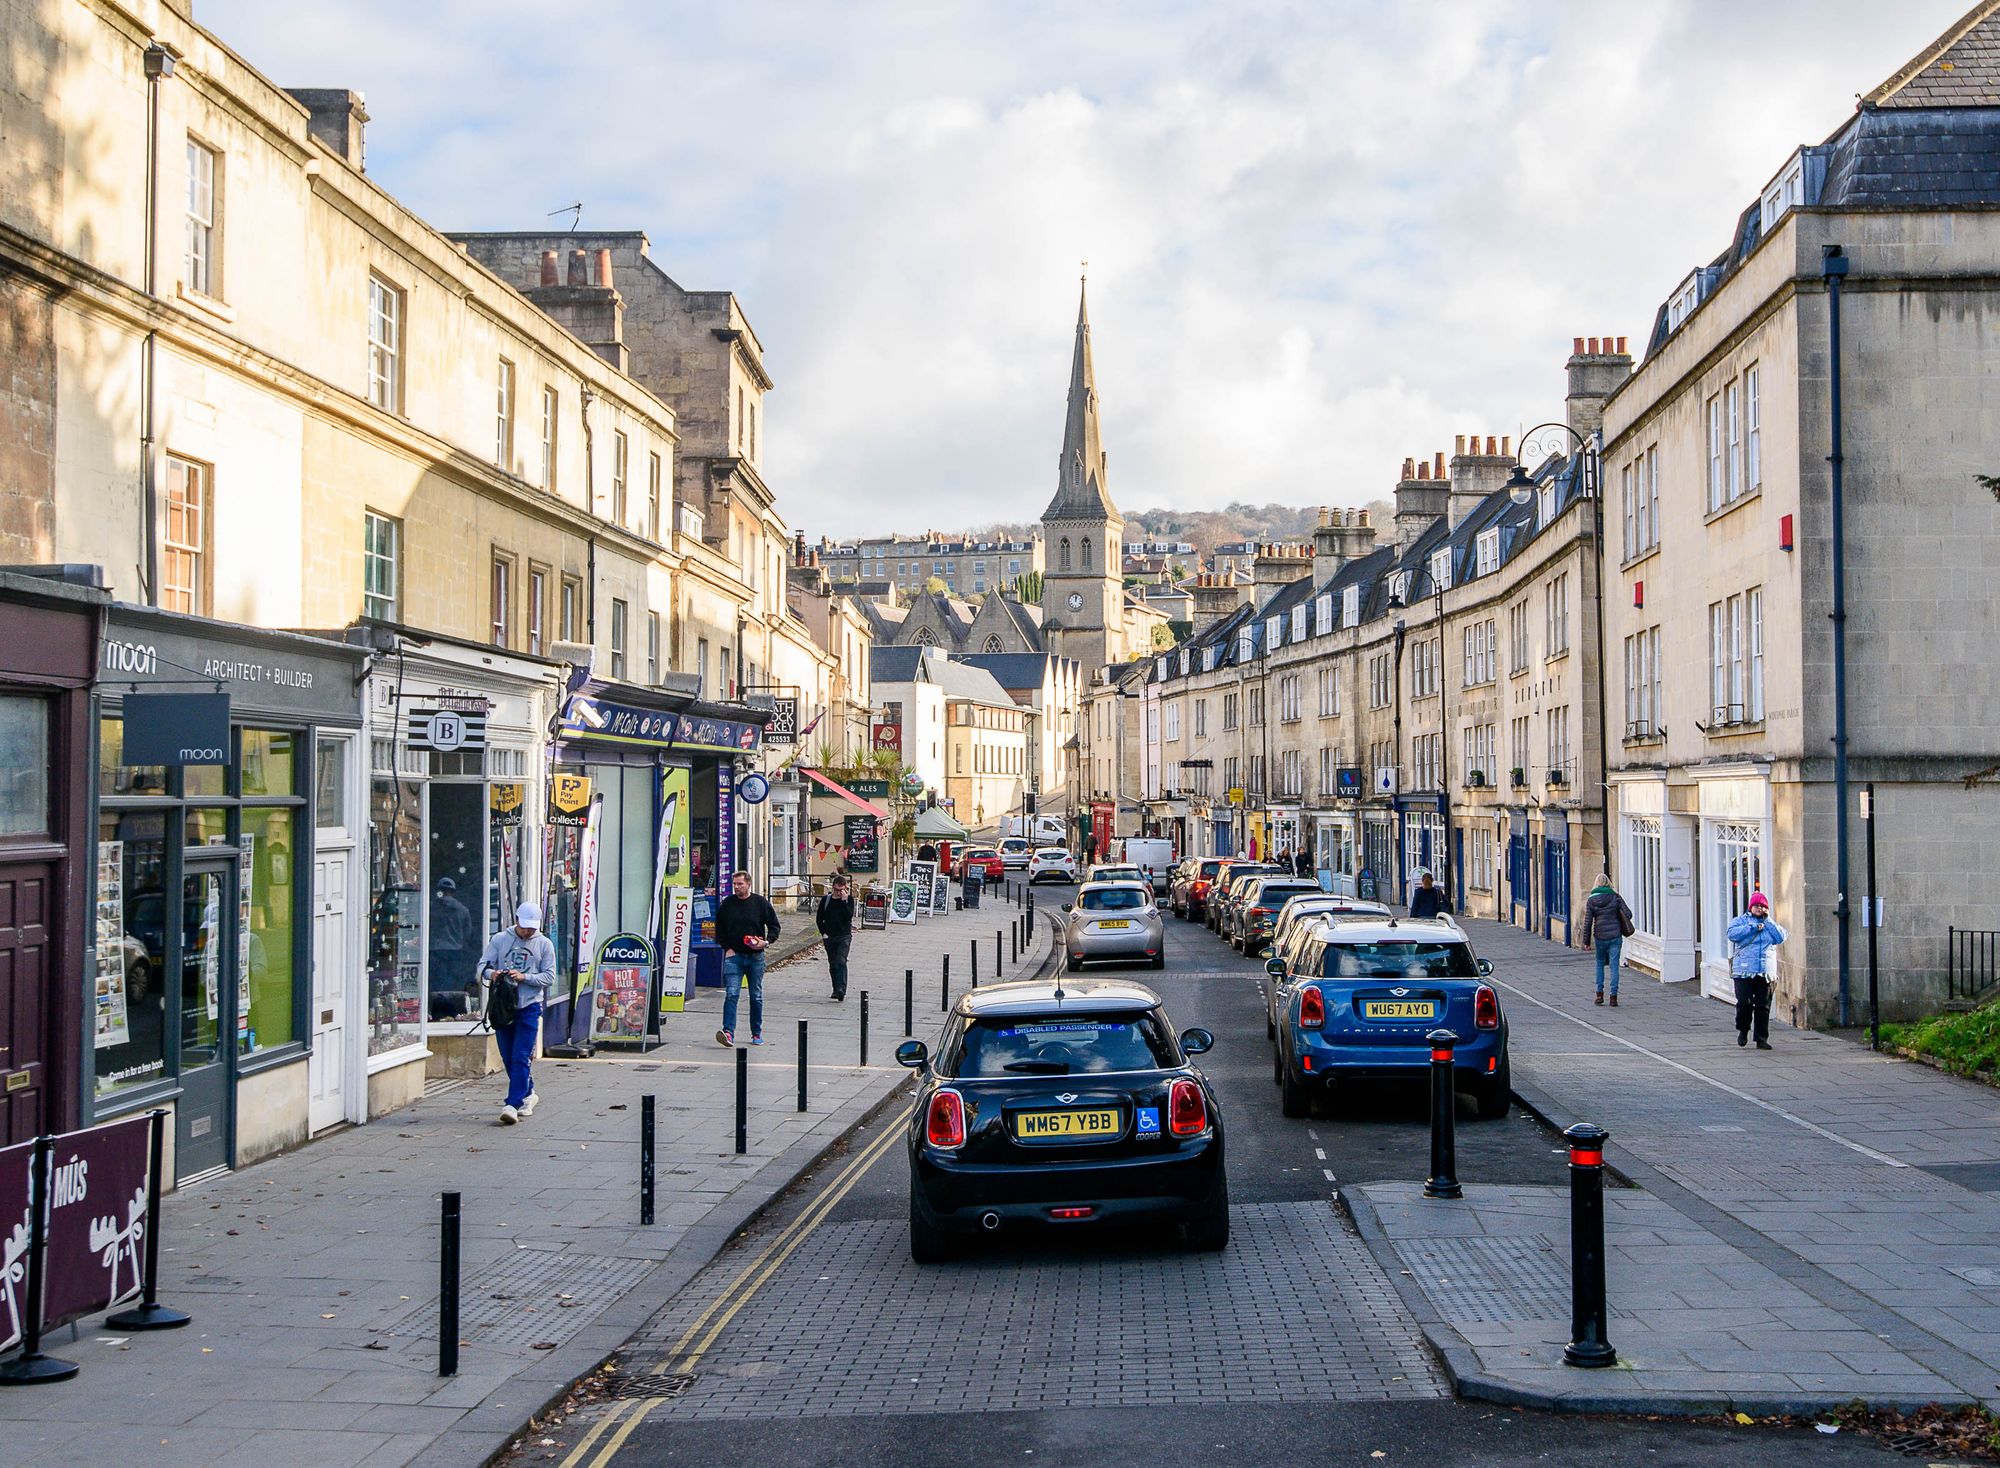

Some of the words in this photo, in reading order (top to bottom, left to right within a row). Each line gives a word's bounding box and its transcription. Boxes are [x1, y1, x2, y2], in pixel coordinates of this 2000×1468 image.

[107, 640, 157, 675] moon
[204, 659, 262, 682] ARCHITECT
[274, 668, 313, 689] BUILDER
[440, 723, 454, 739] B
[774, 723, 794, 732] KEY
[768, 735, 791, 743] 425533
[180, 748, 223, 761] moon
[560, 790, 573, 801] Pay
[1340, 787, 1360, 795] VET
[559, 797, 582, 806] Point
[669, 903, 688, 964] Safeway
[605, 947, 647, 959] McColl's
[614, 970, 633, 980] HOT
[614, 979, 634, 988] VALUE
[1371, 1004, 1403, 1015] WU67
[1406, 1004, 1429, 1015] AYO
[1014, 1025, 1058, 1035] DISABLED
[1060, 1024, 1112, 1032] PASSENGER
[109, 1071, 124, 1081] Come
[124, 1068, 131, 1078] in
[130, 1066, 138, 1076] for
[142, 1063, 152, 1073] free
[1025, 1115, 1071, 1133] WM67
[1076, 1113, 1111, 1131] YBB
[1136, 1132, 1161, 1140] COOPER
[53, 1153, 88, 1209] MÚS
